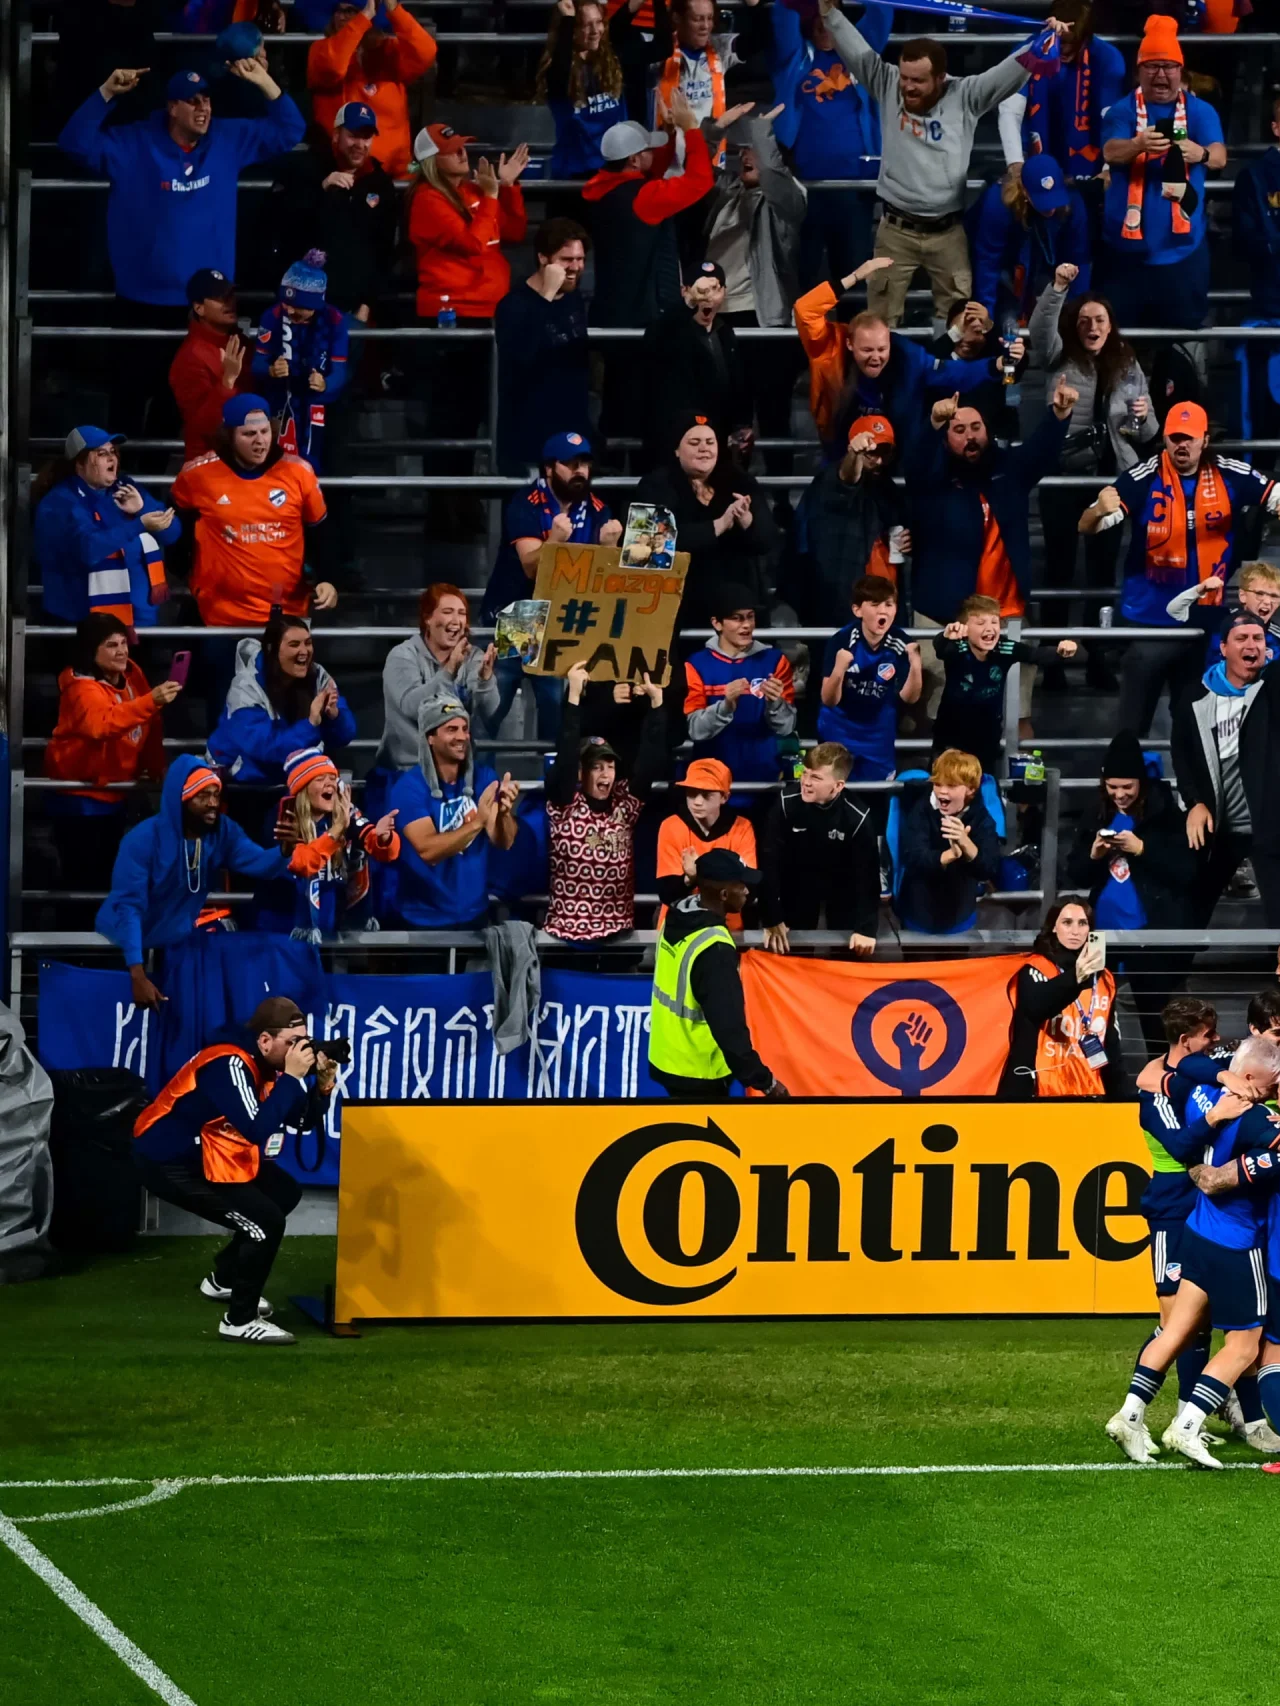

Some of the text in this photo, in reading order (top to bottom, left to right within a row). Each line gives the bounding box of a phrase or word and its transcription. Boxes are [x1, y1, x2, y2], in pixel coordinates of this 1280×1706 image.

[589, 100, 620, 115] HEALT
[241, 531, 287, 544] HEALTH
[551, 547, 684, 615] Miazga
[542, 639, 668, 685] FAN
[575, 1115, 1151, 1306] Contine
